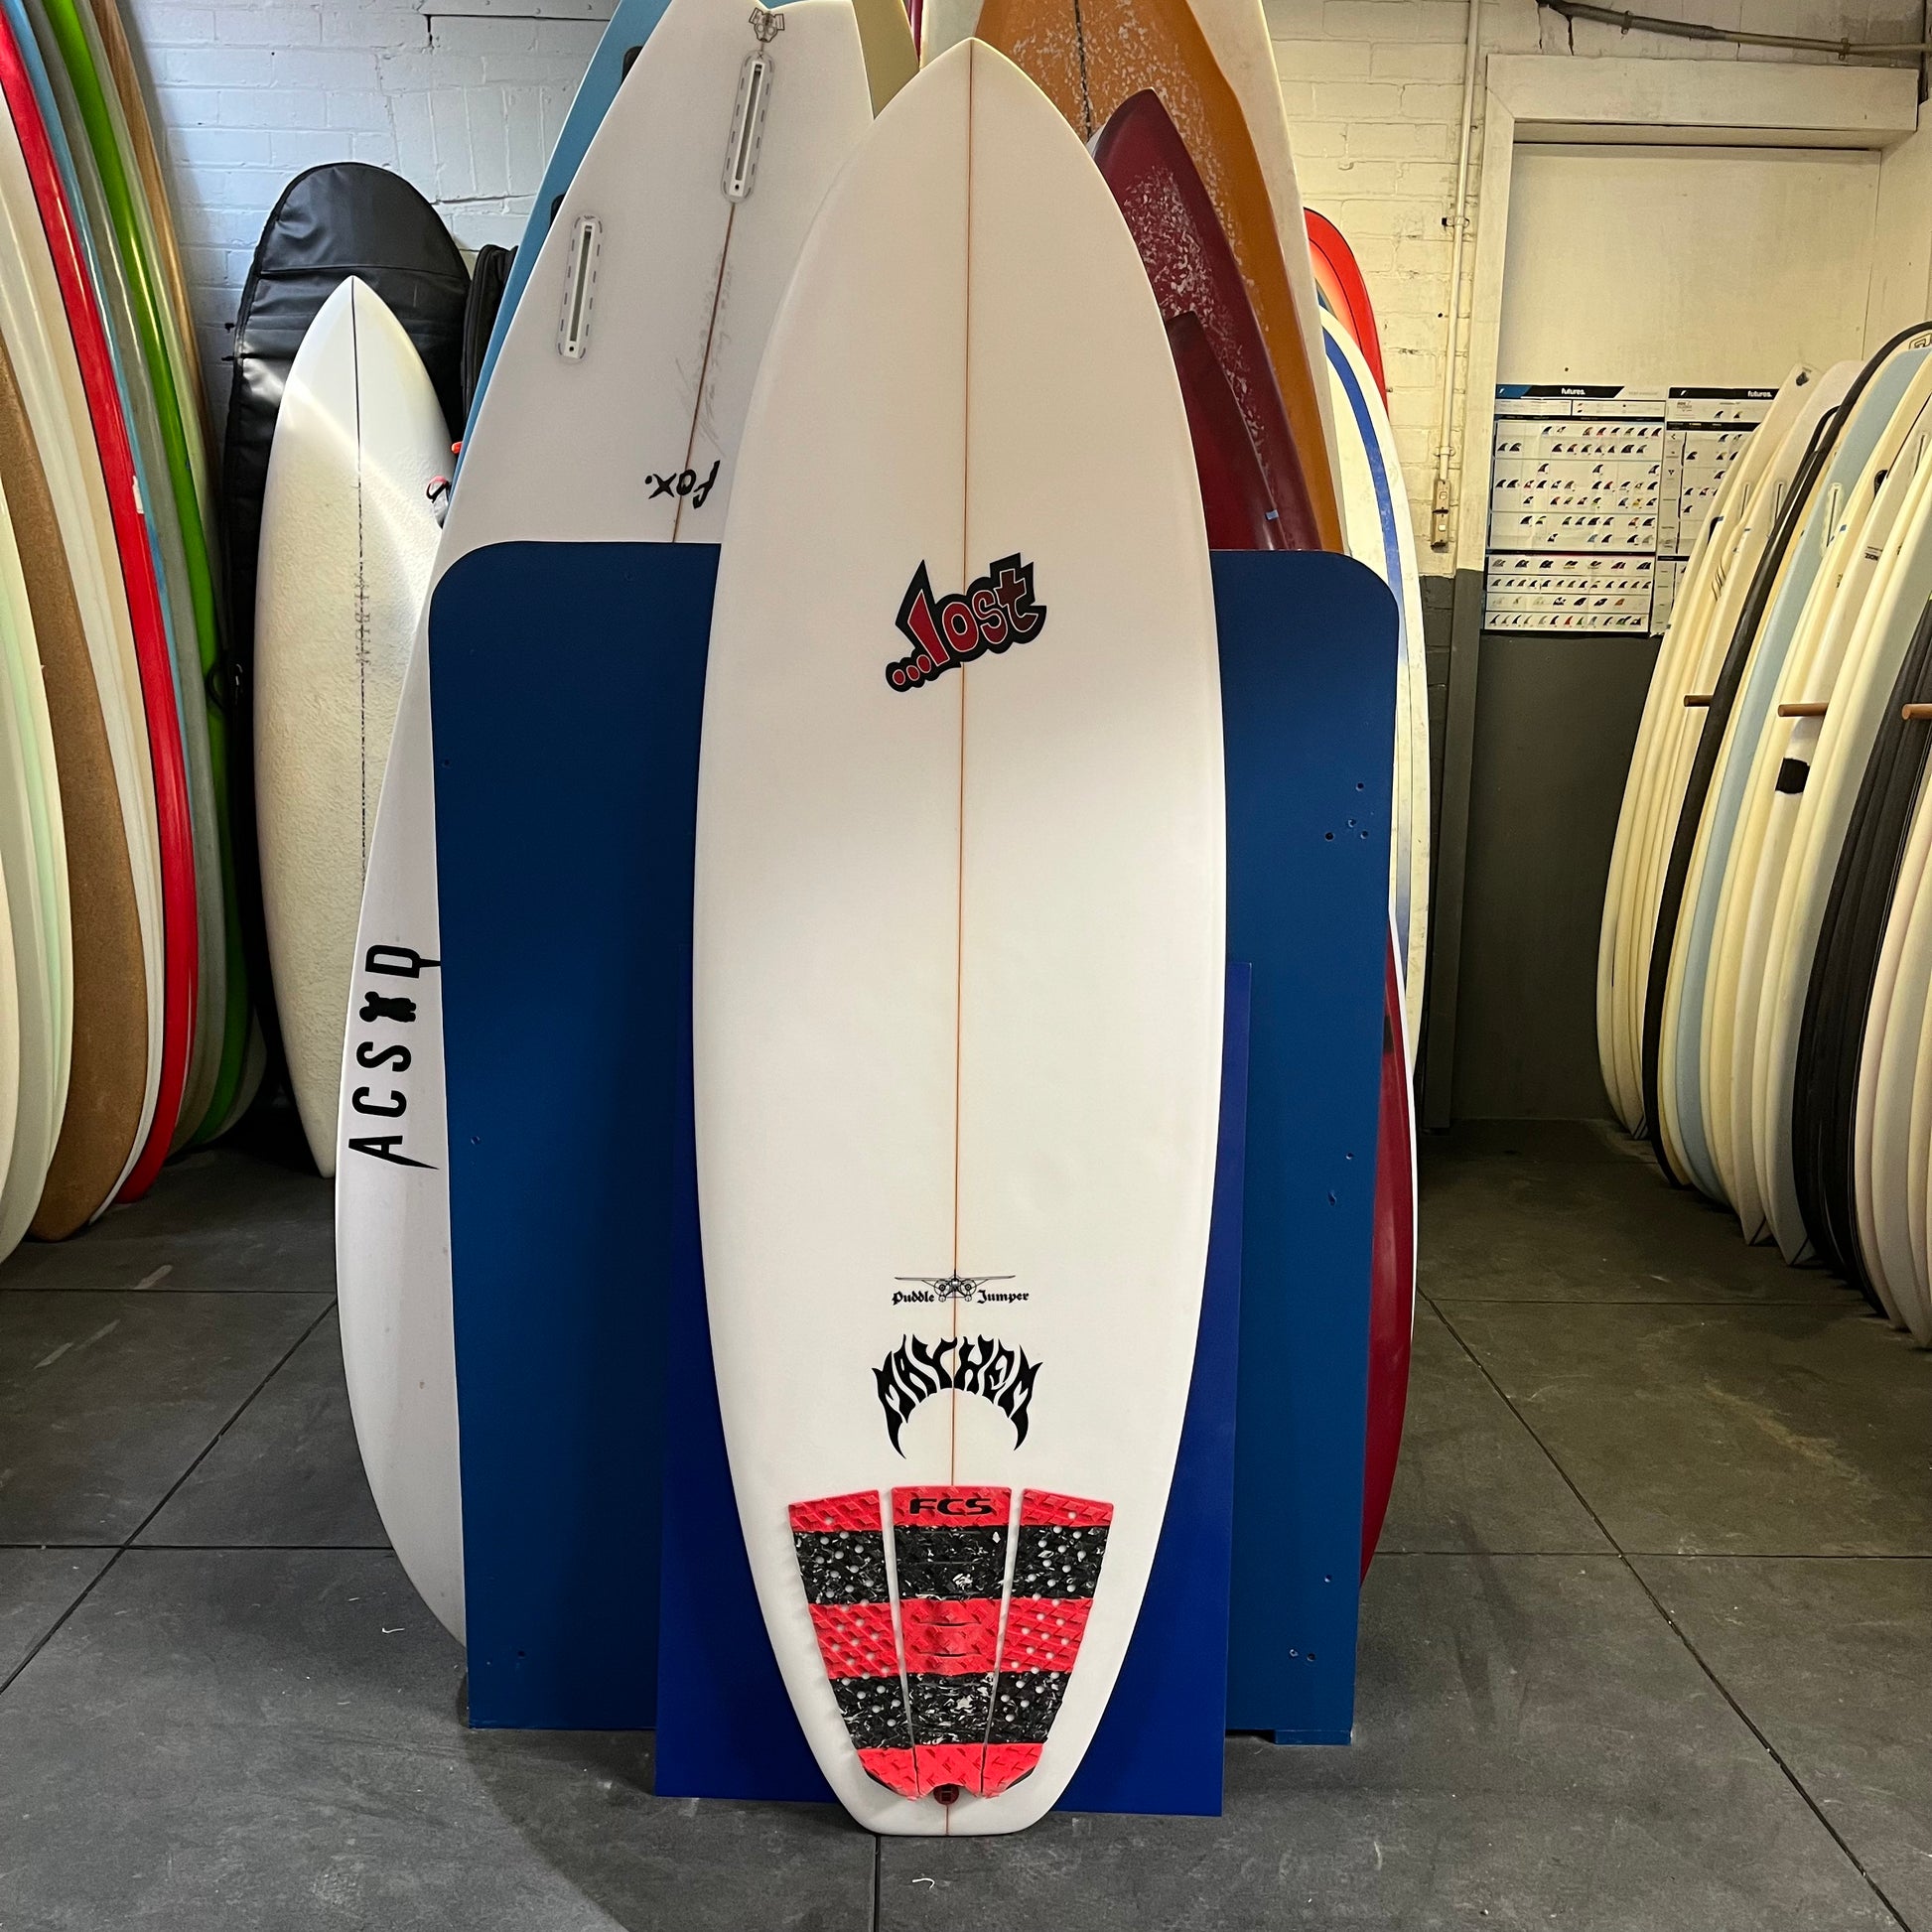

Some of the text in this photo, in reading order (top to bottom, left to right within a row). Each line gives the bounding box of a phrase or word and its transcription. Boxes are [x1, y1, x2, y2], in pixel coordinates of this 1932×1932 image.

[892, 1289, 1030, 1306] Puddle Jumper
[909, 1497, 994, 1516] FCS
